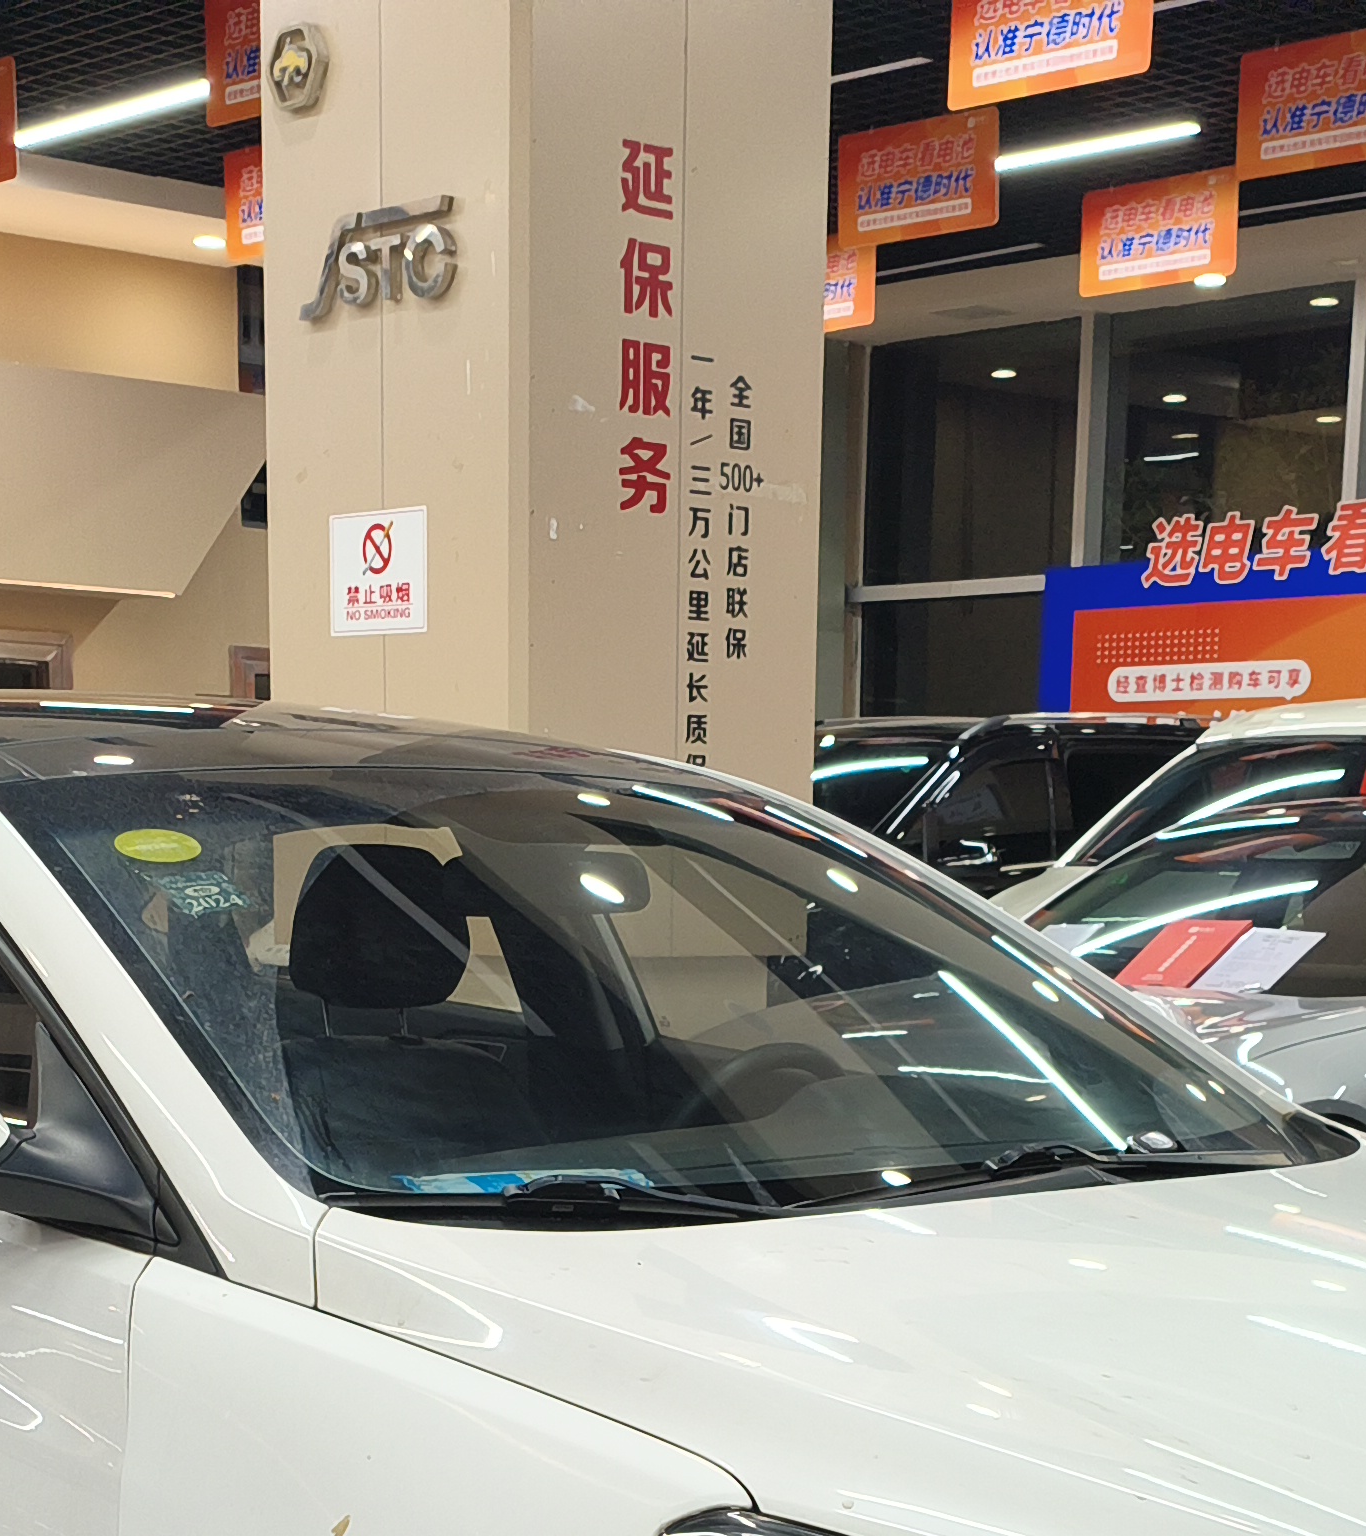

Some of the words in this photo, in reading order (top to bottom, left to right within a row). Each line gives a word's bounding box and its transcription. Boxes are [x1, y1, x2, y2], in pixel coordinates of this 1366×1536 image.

[972, 3, 1123, 64] 认准宁德时代
[855, 167, 975, 213] 认准宁德时代
[1097, 222, 1214, 263] 认准宁德时代
[619, 138, 674, 514] 延保服务
[346, 581, 412, 607] 禁止吸烟
[346, 608, 362, 622] NO
[364, 606, 412, 621] SMOKING
[1115, 668, 1302, 695] 经查博士检测购车可享
